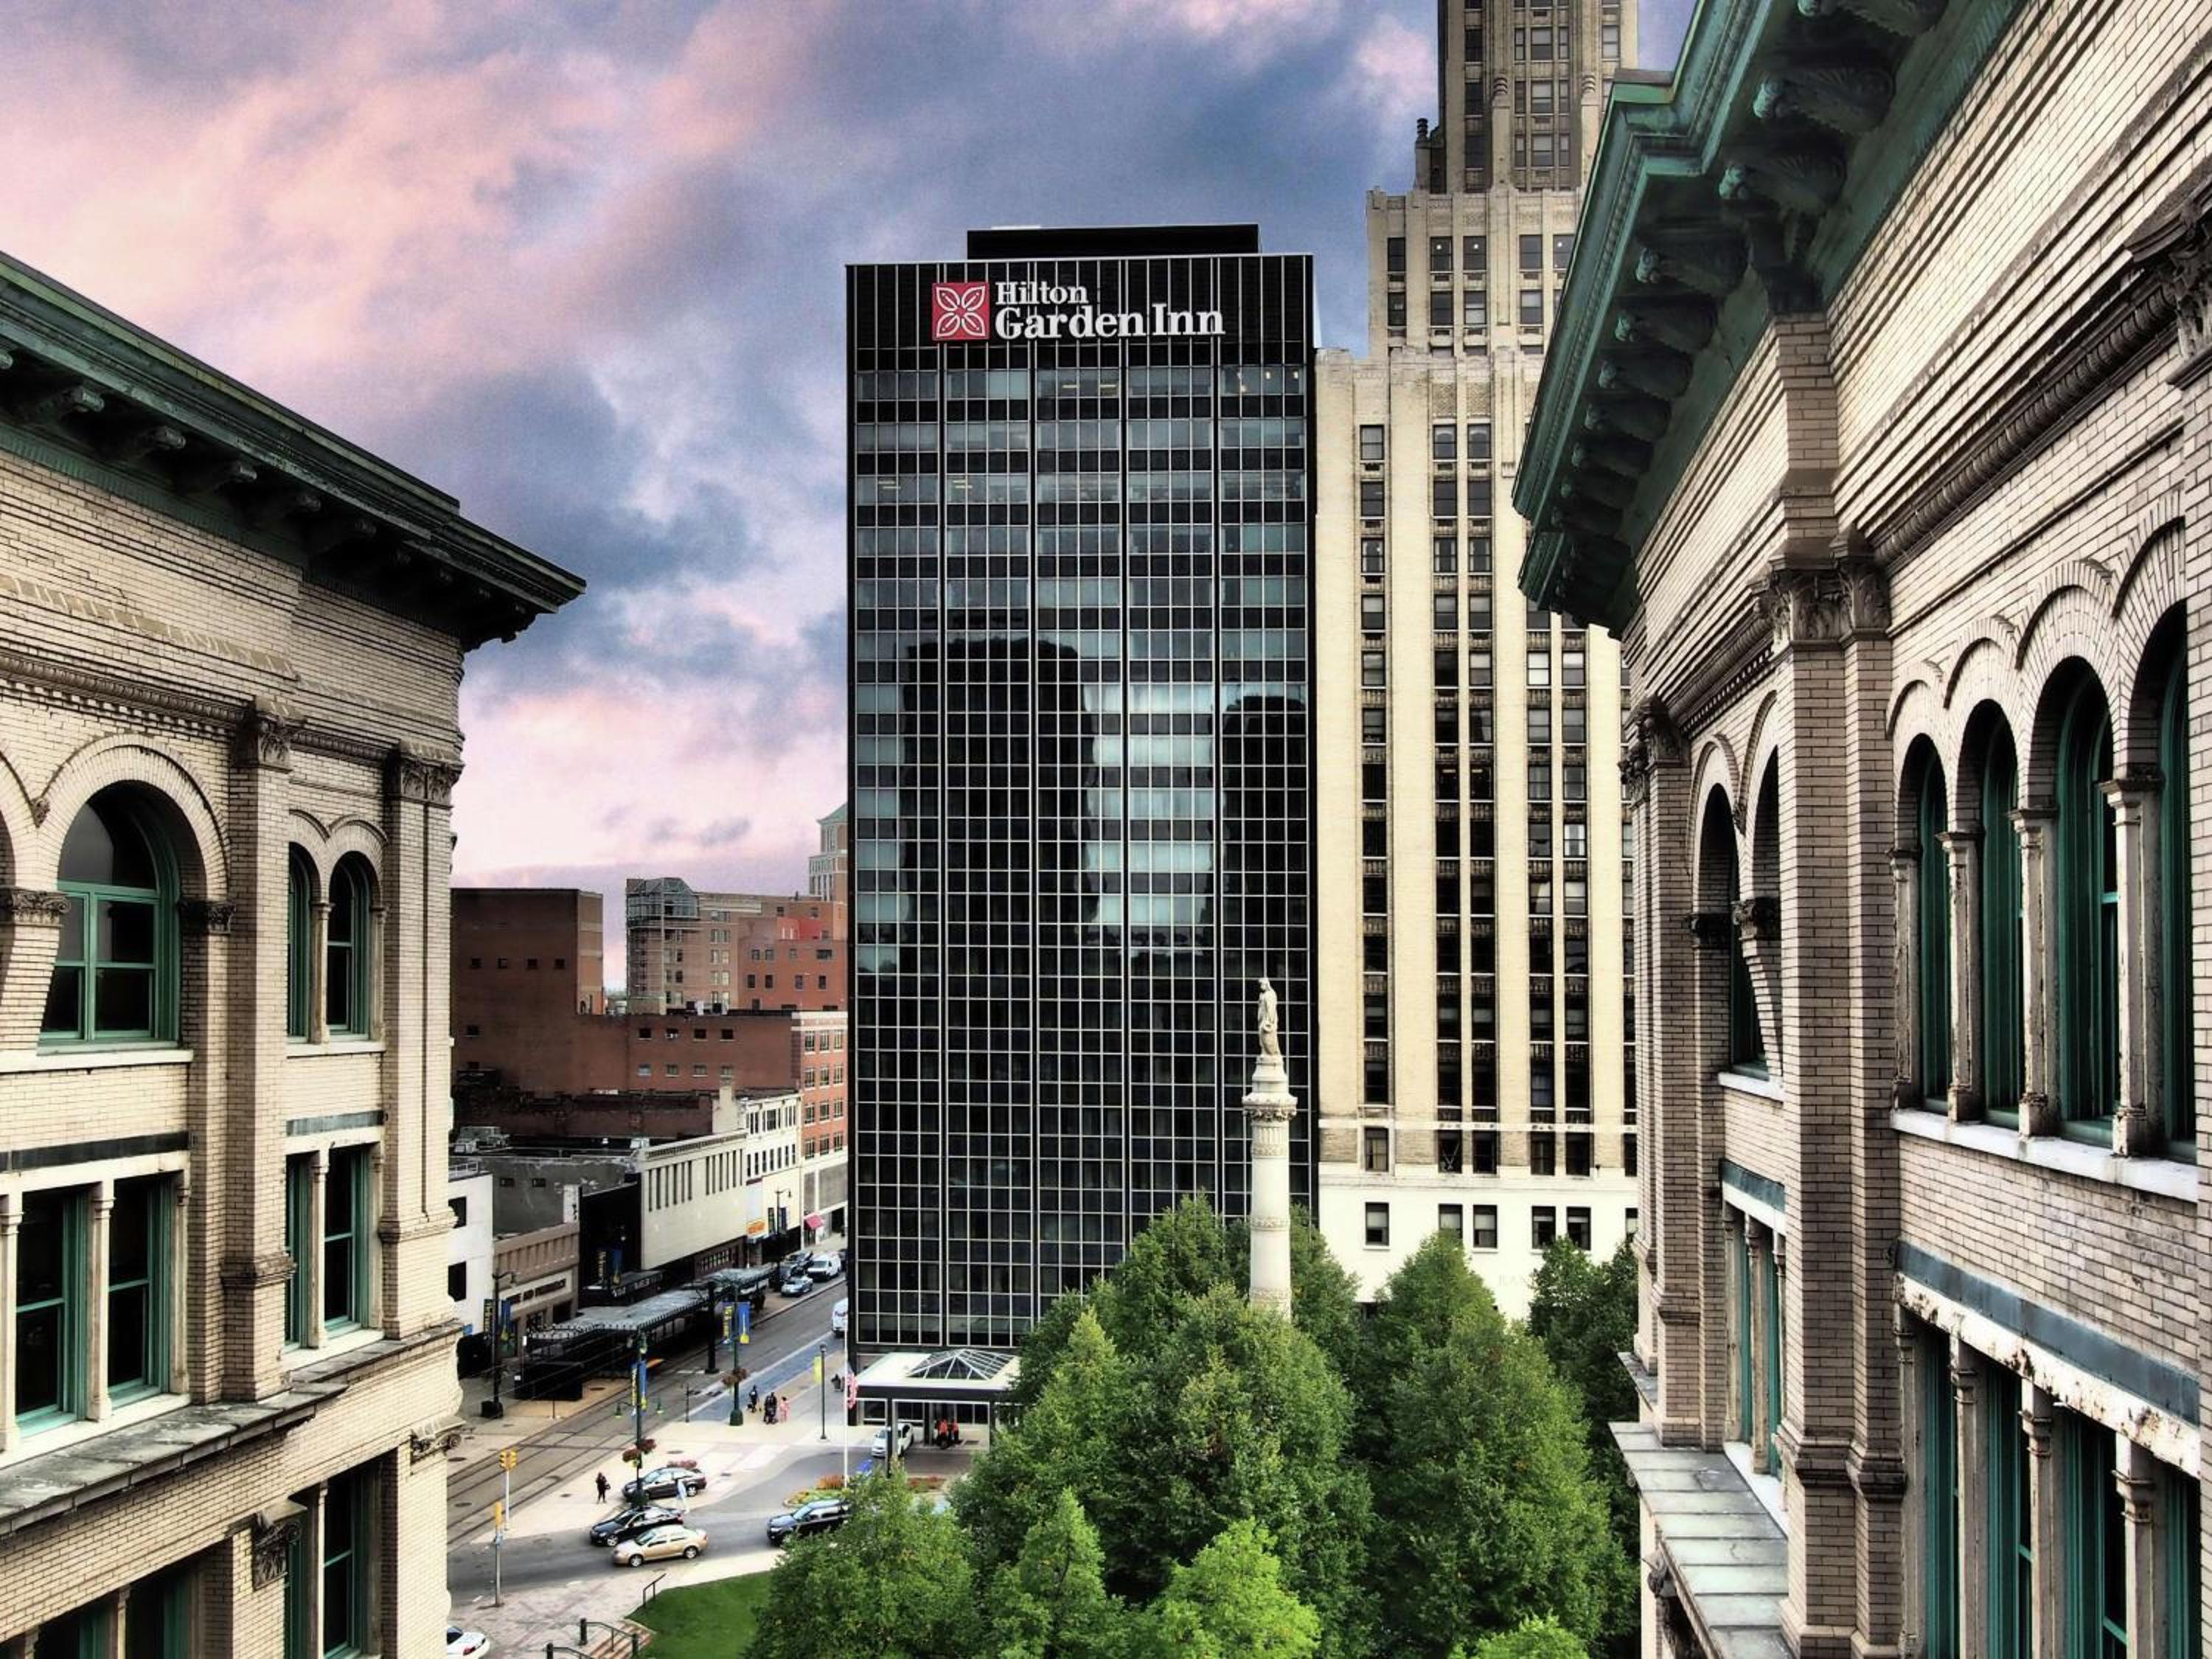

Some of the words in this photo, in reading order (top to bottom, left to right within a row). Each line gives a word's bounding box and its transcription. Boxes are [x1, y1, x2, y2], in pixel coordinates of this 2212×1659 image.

[995, 281, 1089, 305] Hilton
[995, 305, 1147, 339] Garden
[1152, 303, 1226, 335] Inn
